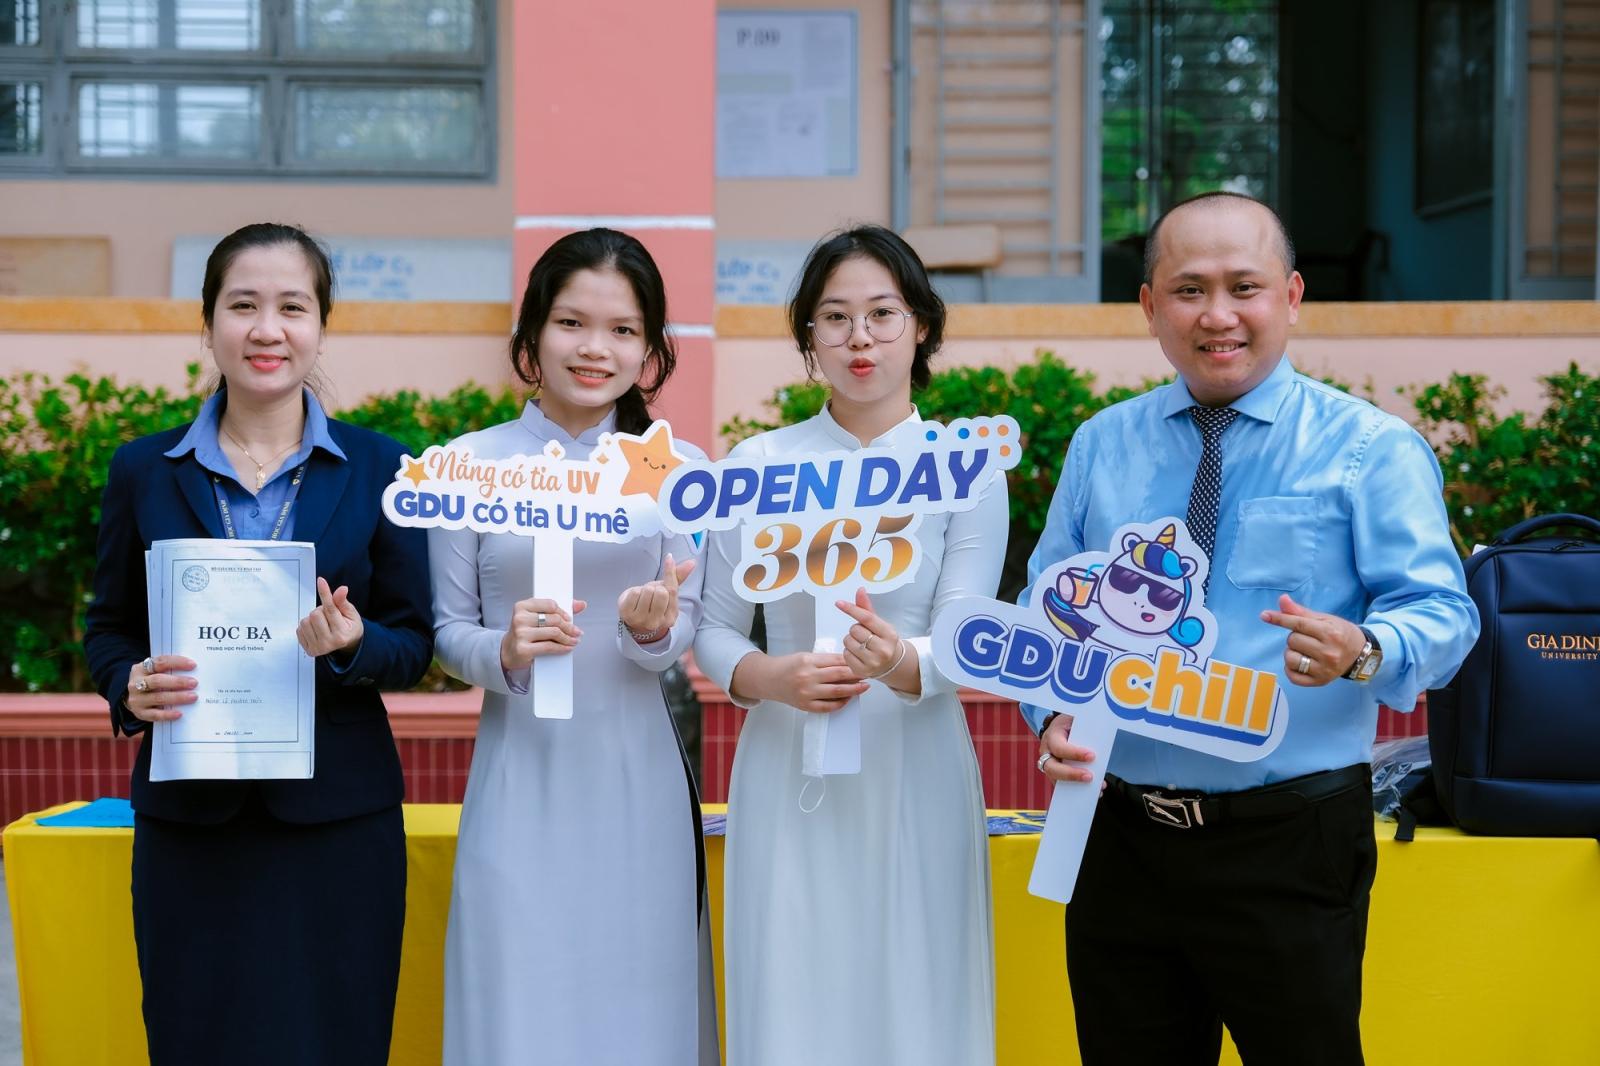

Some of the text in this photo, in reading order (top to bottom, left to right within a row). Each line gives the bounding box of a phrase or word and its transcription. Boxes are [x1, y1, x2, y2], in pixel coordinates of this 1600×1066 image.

[429, 451, 600, 498] Nắng có tia UV
[669, 448, 989, 522] OPEN DAY
[393, 490, 629, 535] GDU có tia U mê
[743, 513, 915, 592] 365
[197, 626, 272, 643] HỌC BẠ
[1527, 634, 1600, 650] GIA DIN
[1541, 652, 1598, 660] UNIVERSITY
